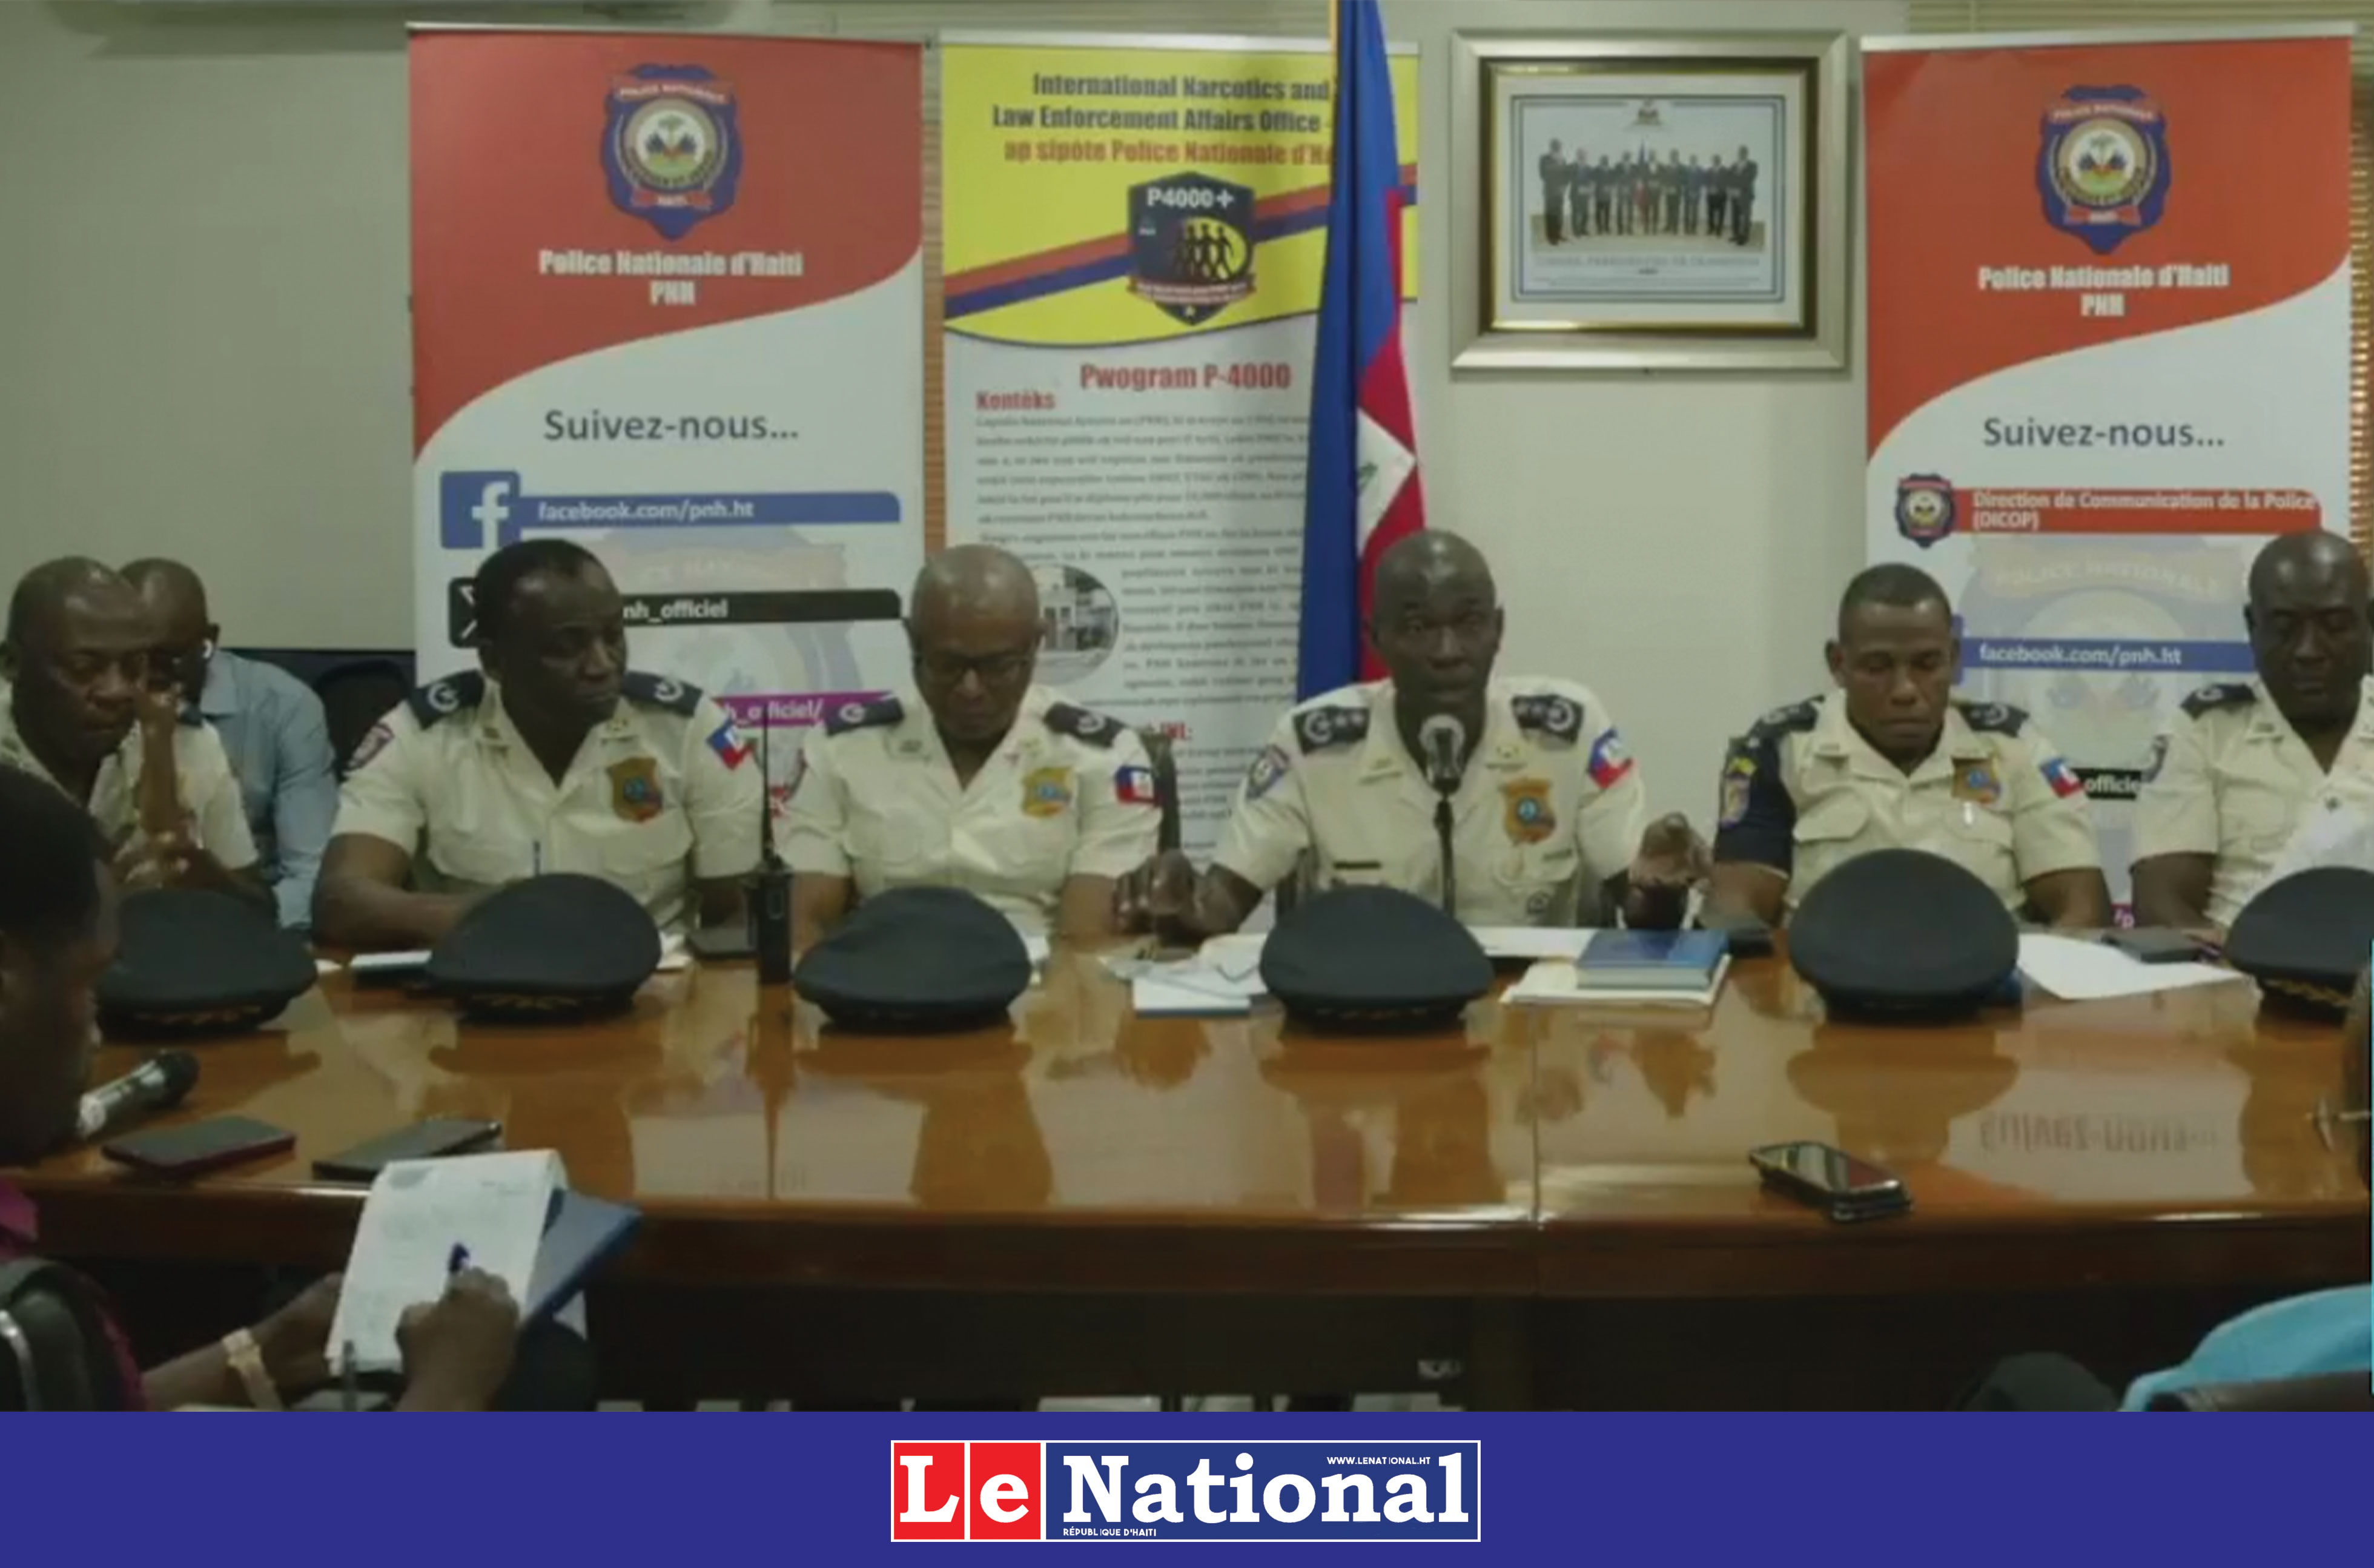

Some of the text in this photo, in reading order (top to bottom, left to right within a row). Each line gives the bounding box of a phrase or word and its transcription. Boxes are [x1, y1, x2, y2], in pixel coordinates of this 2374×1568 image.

[1033, 73, 1329, 100] International Narcotics and
[993, 104, 1320, 133] Law Enforcement Affairs Office
[1004, 142, 1031, 164] ap
[1112, 139, 1178, 163] Police
[1185, 141, 1286, 165] Nationale
[538, 250, 610, 276] Police
[616, 250, 726, 276] Nationale
[1977, 266, 2046, 289] Police
[2050, 266, 2154, 289] Nationale
[649, 280, 696, 305] PNH
[2080, 293, 2126, 317] PNH
[1080, 362, 1292, 392] Pwogram P-4000
[544, 409, 799, 442] Suivez-nous...
[1982, 417, 2224, 447] Suivez-nous...
[538, 499, 755, 523] facebook.com/pnh.ht
[1972, 489, 2316, 509] Direction de Communication de la Police
[1972, 510, 2039, 531] (DICOP)
[1979, 643, 2182, 666] facebook.com/pnh.ht
